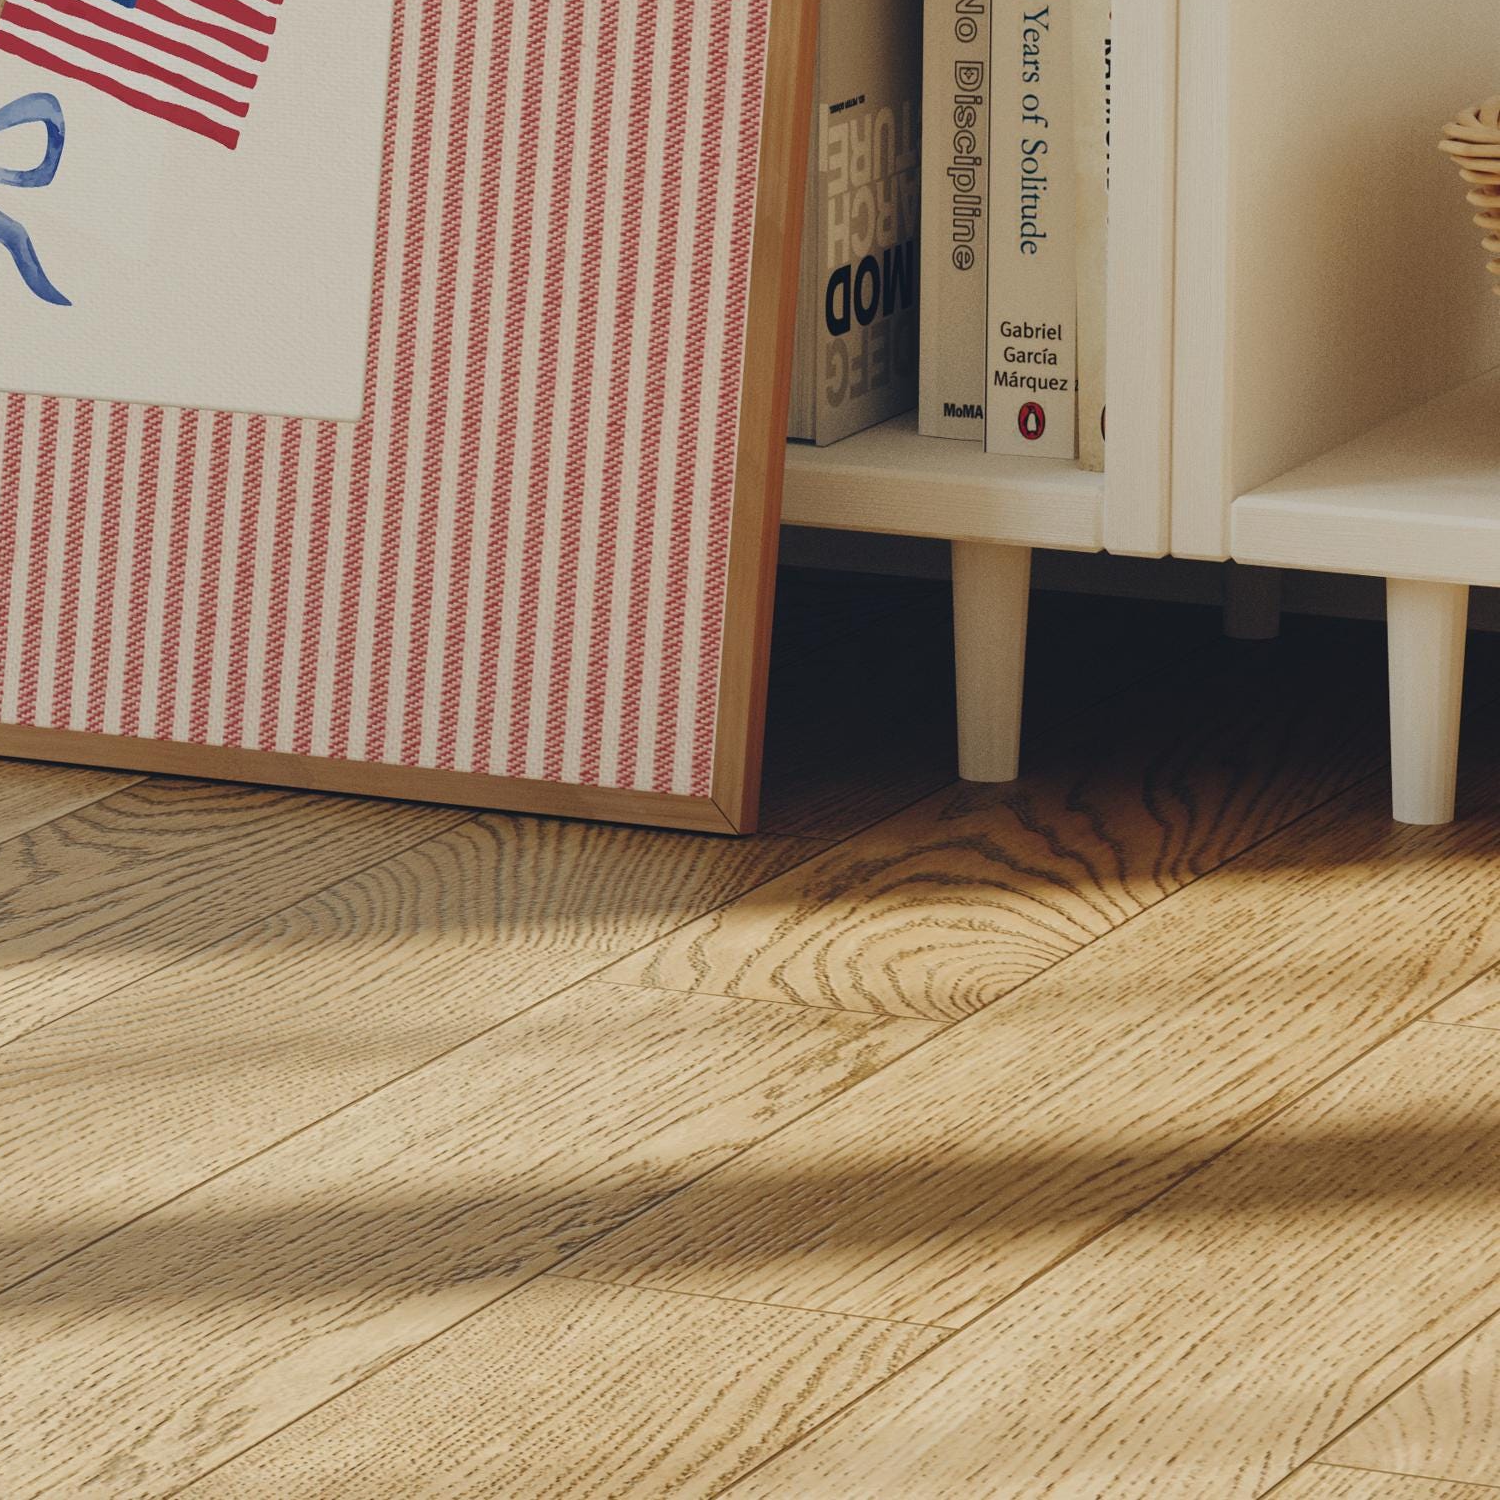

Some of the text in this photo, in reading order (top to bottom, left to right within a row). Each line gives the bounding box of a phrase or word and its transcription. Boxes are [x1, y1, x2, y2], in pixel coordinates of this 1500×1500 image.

[1022, 5, 1049, 83] Years
[1022, 94, 1048, 128] of
[947, 60, 984, 271] Discipline
[1020, 139, 1048, 255] Solitude
[1000, 321, 1062, 341] Gabriel
[1003, 347, 1057, 365] García
[993, 370, 1068, 393] Márquez
[943, 402, 984, 420] MoMA
